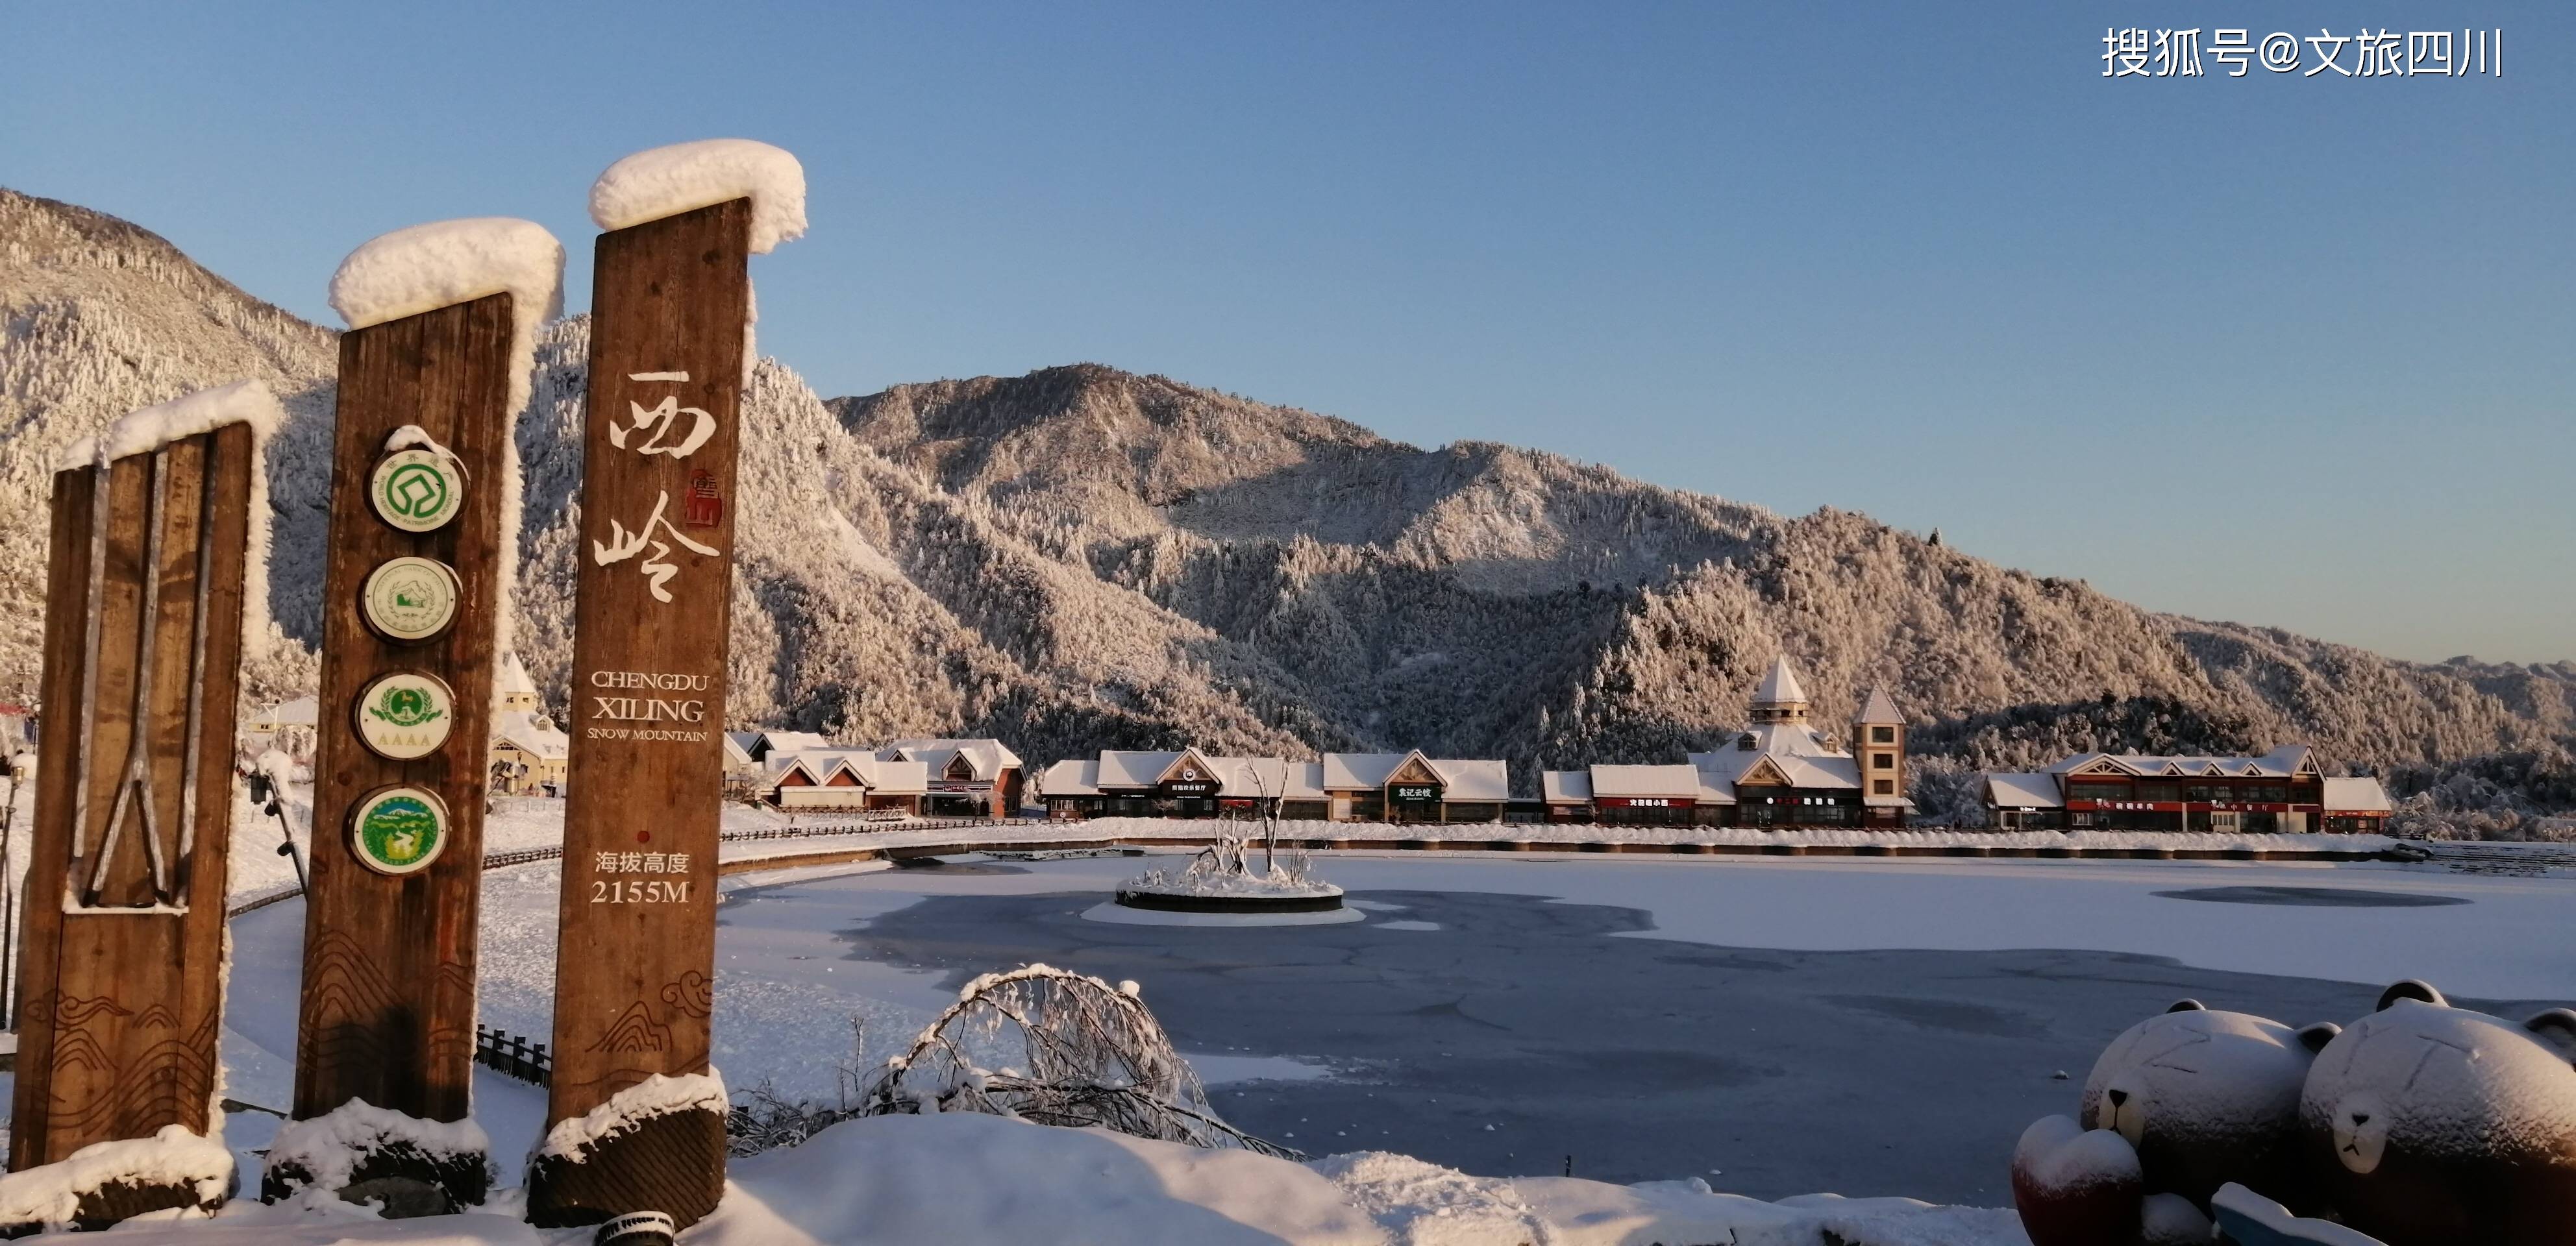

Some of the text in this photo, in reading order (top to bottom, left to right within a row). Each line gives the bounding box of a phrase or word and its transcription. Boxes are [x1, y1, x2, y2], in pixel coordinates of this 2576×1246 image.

[591, 670, 710, 691] CHENGDU
[592, 696, 705, 723] XILING
[588, 727, 708, 742] SNOW MOUNTAIN
[595, 851, 689, 874] 海拔高度
[591, 881, 690, 904] 2155M
